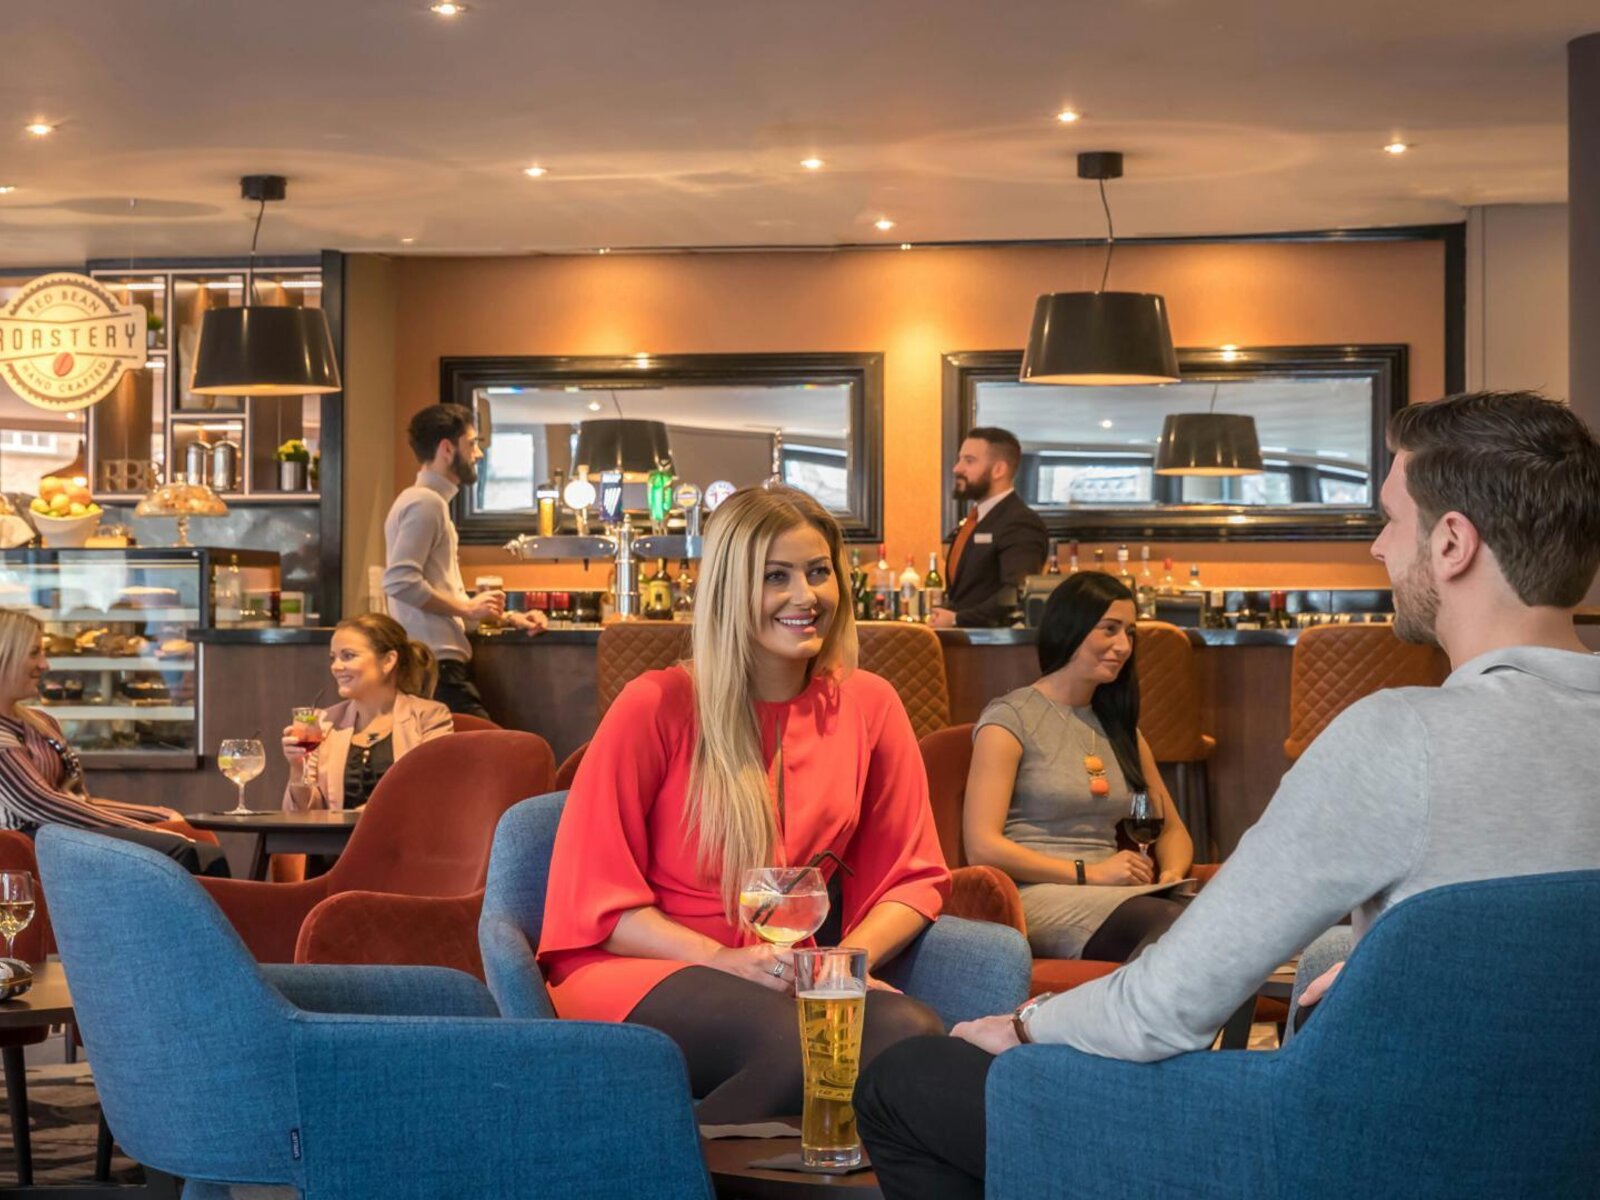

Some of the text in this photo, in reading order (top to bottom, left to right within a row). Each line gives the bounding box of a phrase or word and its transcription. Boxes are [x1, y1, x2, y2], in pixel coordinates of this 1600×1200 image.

[27, 291, 101, 314] RED BEAN
[22, 361, 108, 393] HAND CRAFTED
